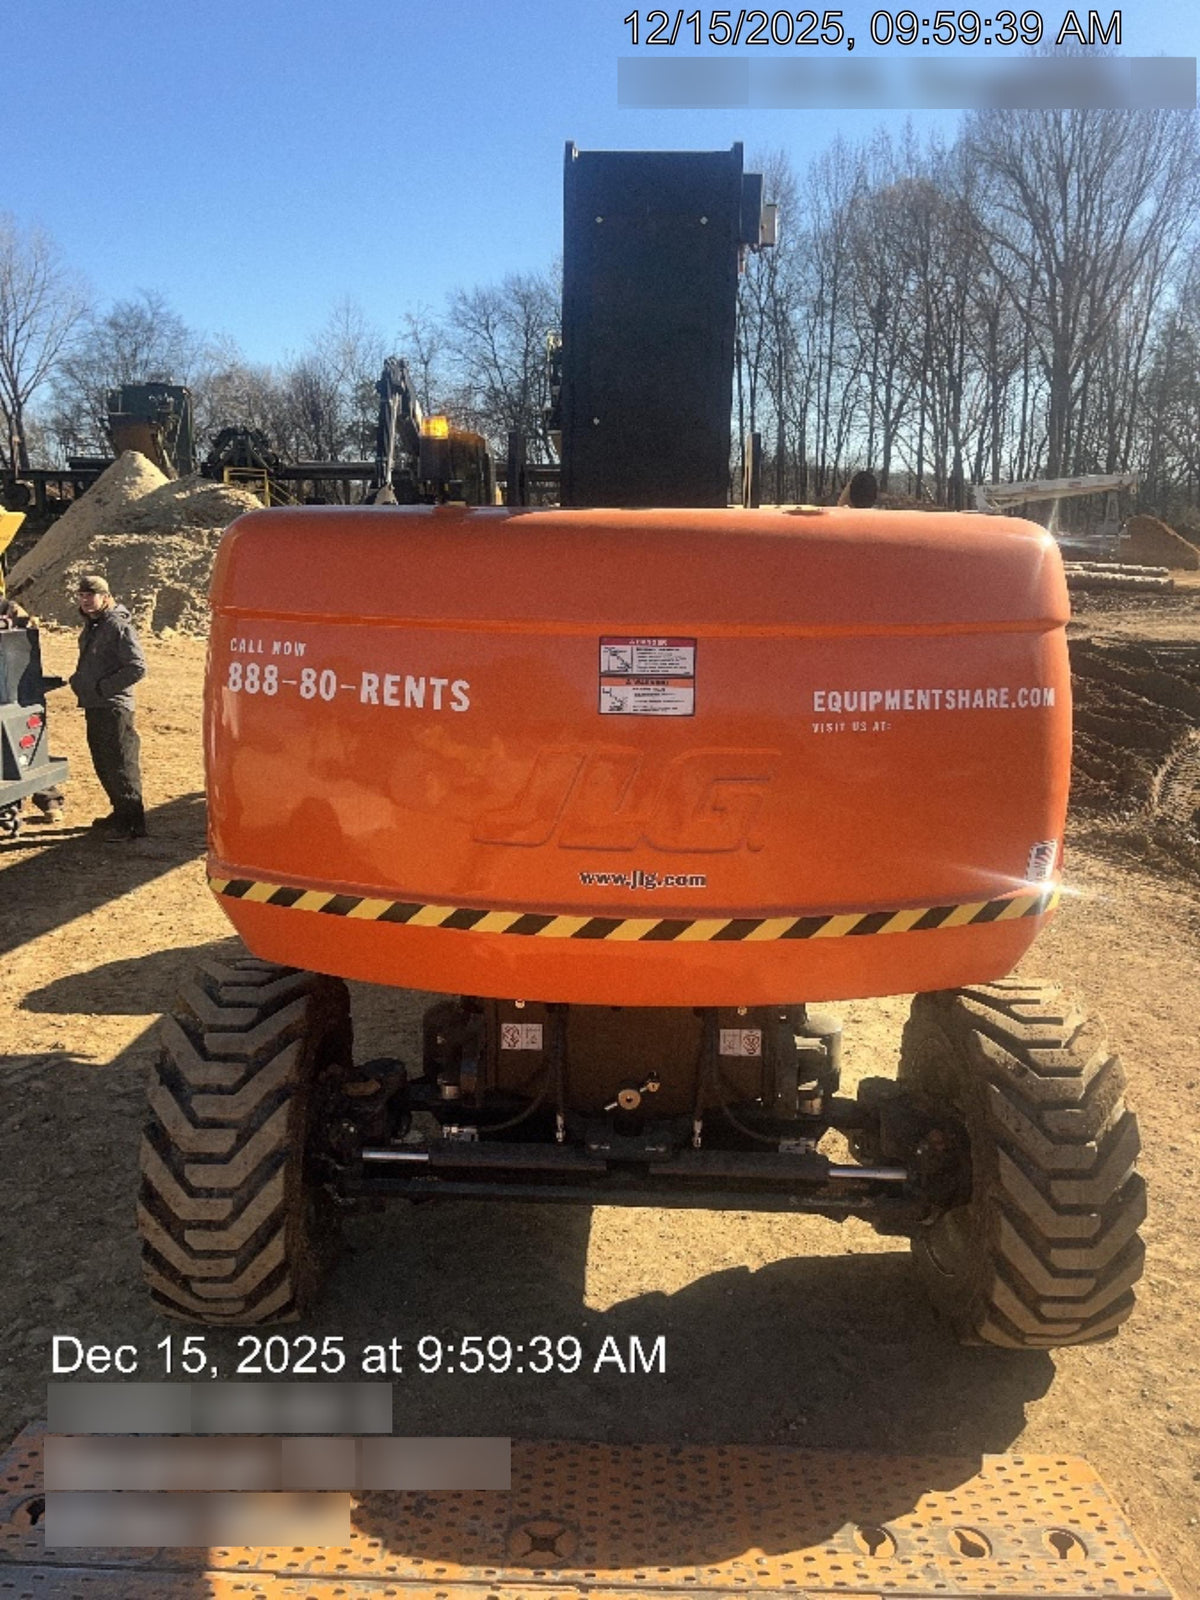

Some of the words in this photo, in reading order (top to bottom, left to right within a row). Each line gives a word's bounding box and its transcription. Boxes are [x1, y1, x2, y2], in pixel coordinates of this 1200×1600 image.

[230, 638, 264, 653] CALL
[271, 641, 307, 656] NOW
[227, 662, 471, 712] 888-80-RENTS
[813, 687, 1056, 713] EQUIPMENTSHARE.COM
[812, 722, 845, 733] VISIT
[852, 721, 867, 732] US
[579, 870, 707, 890] www.jlg.com
